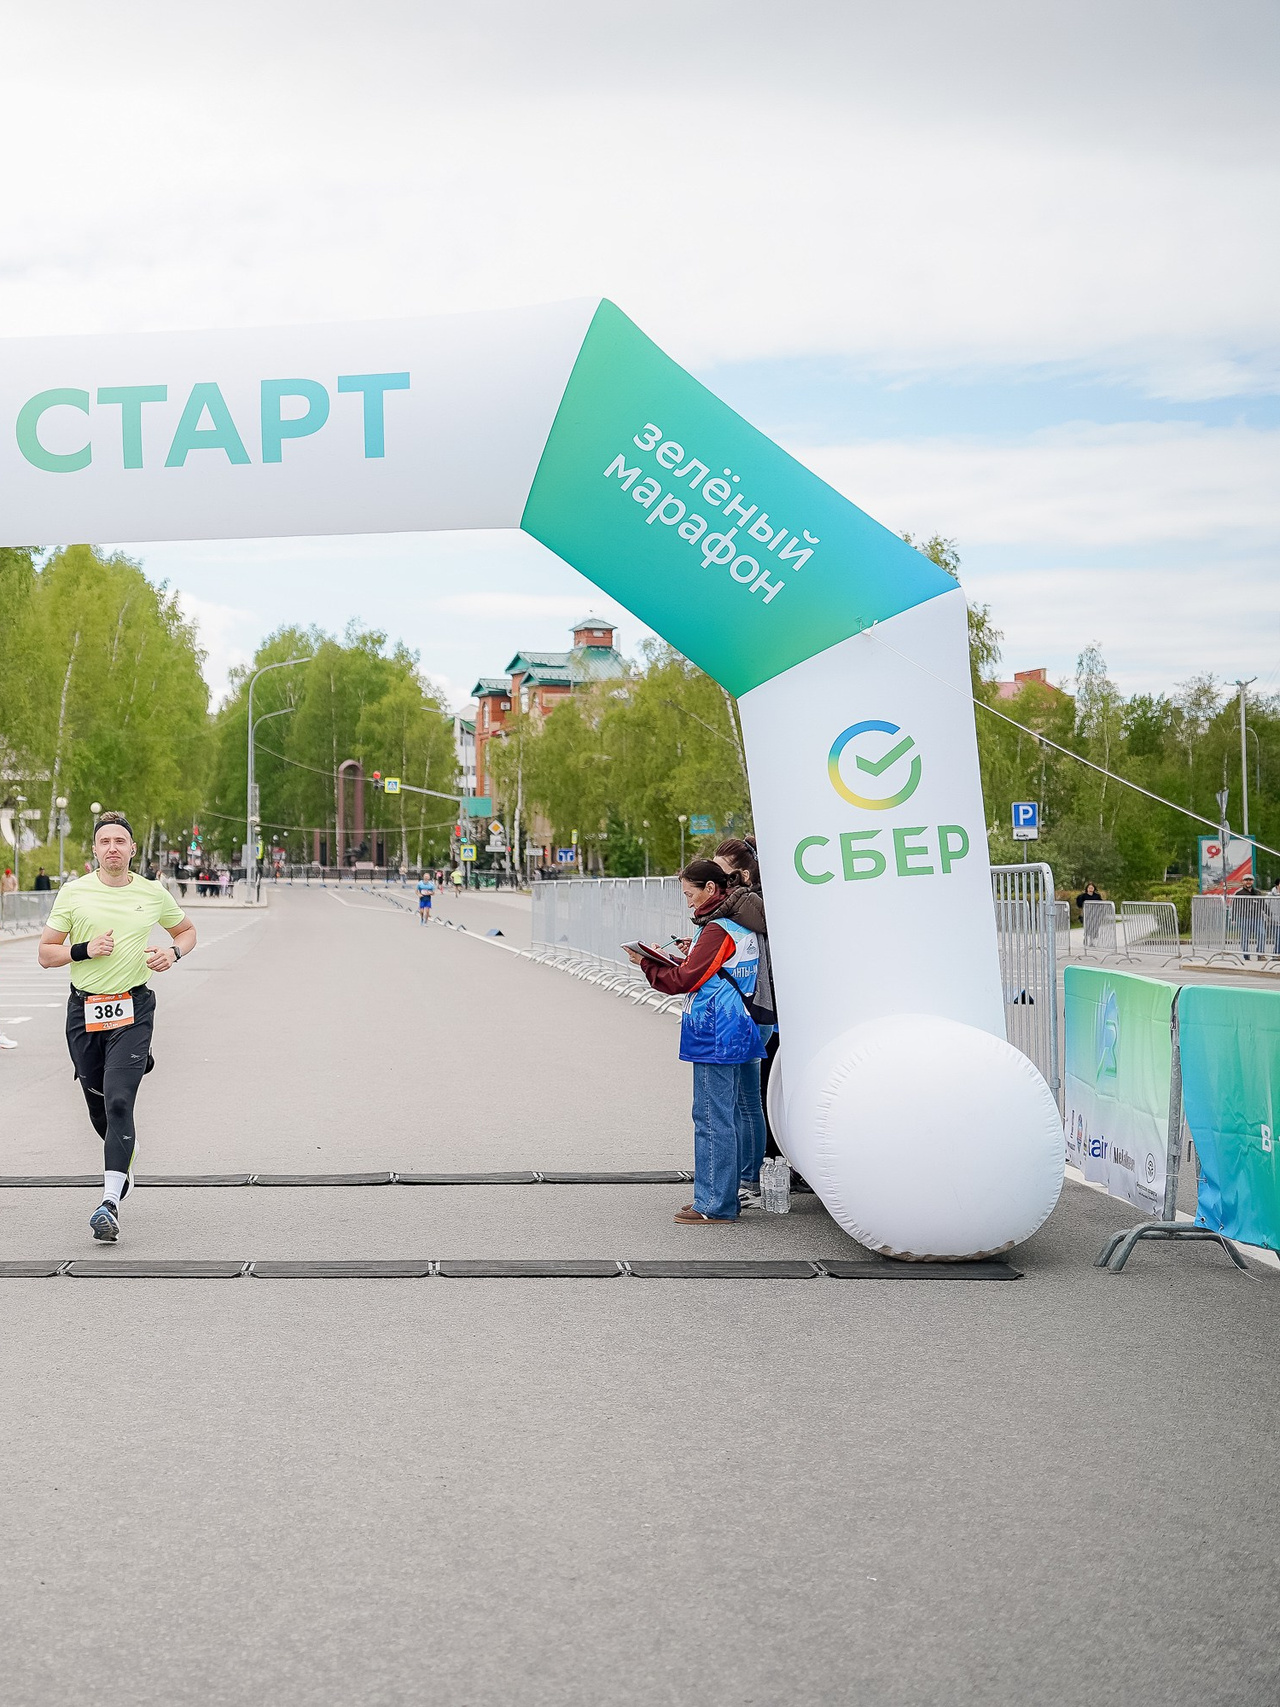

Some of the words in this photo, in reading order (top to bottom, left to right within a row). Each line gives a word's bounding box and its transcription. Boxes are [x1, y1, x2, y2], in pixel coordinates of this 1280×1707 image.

[16, 372, 411, 474] СТАРТ
[603, 453, 786, 605] марафон
[632, 422, 821, 573] зелёный
[793, 824, 971, 885] СБЕР
[1019, 805, 1034, 826] P
[94, 1003, 124, 1020] 386
